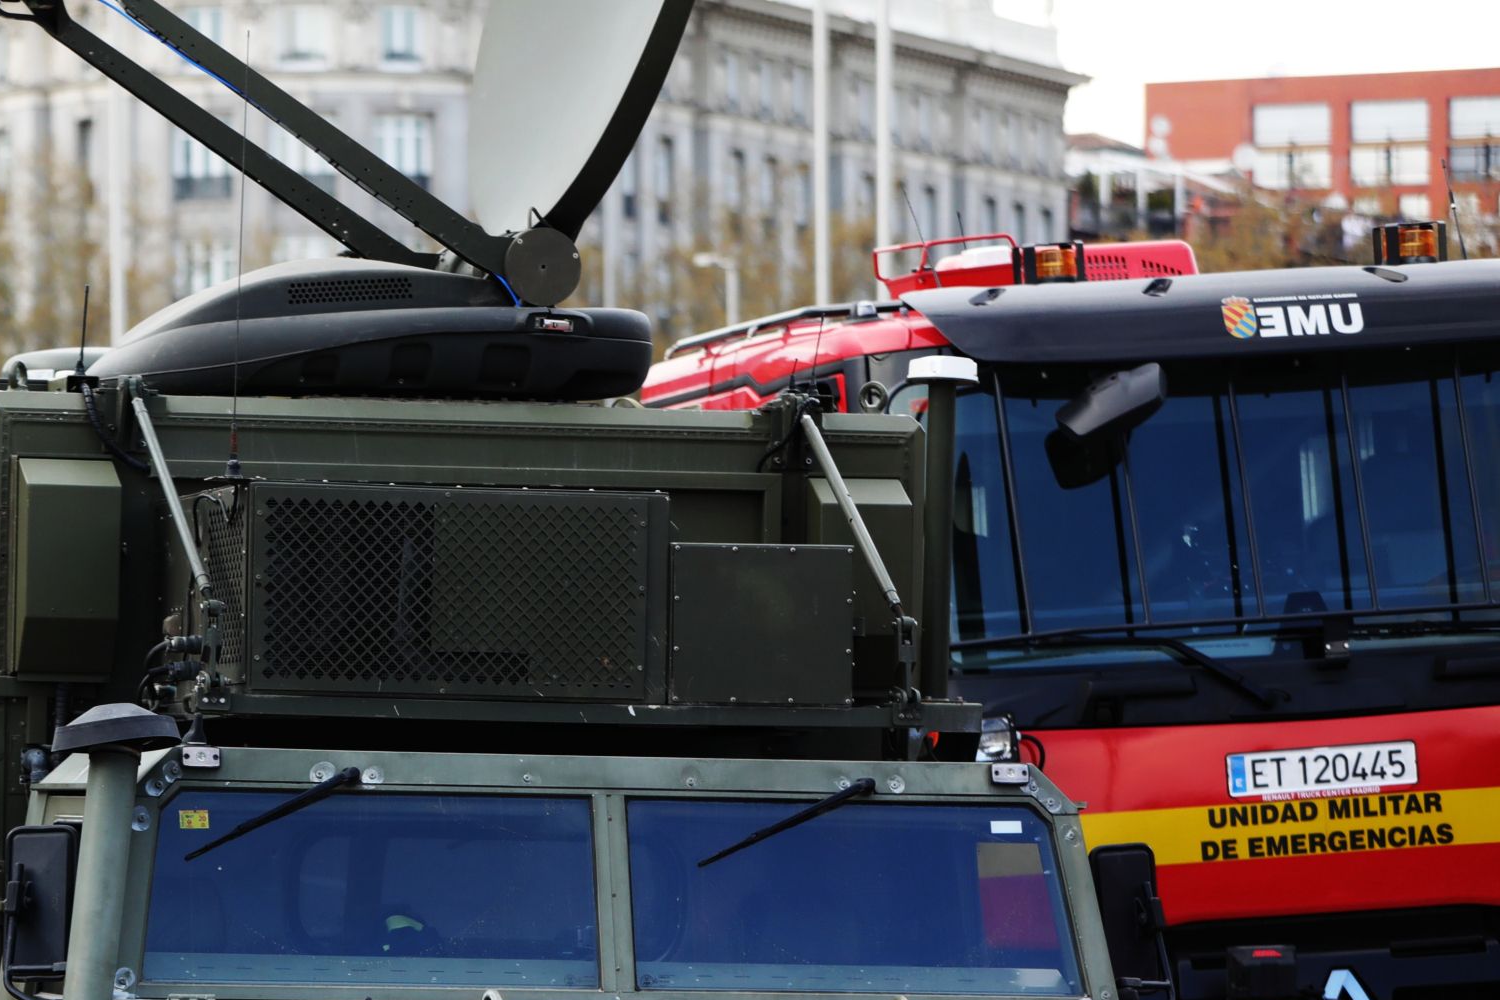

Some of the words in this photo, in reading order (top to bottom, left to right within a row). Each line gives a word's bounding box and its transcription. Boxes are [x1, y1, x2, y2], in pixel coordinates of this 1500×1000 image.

[1251, 757, 1287, 788] ET
[1299, 749, 1406, 785] 120445
[1208, 801, 1318, 829] UNIDAD
[1328, 792, 1443, 820] MILITAR
[1262, 791, 1296, 801] RENAULT
[1297, 790, 1320, 799] TRUCK
[1321, 788, 1351, 797] CENTER
[1352, 785, 1380, 795] MADRID
[1201, 839, 1238, 862] DE
[1248, 823, 1454, 858] EMERGENCIAS
